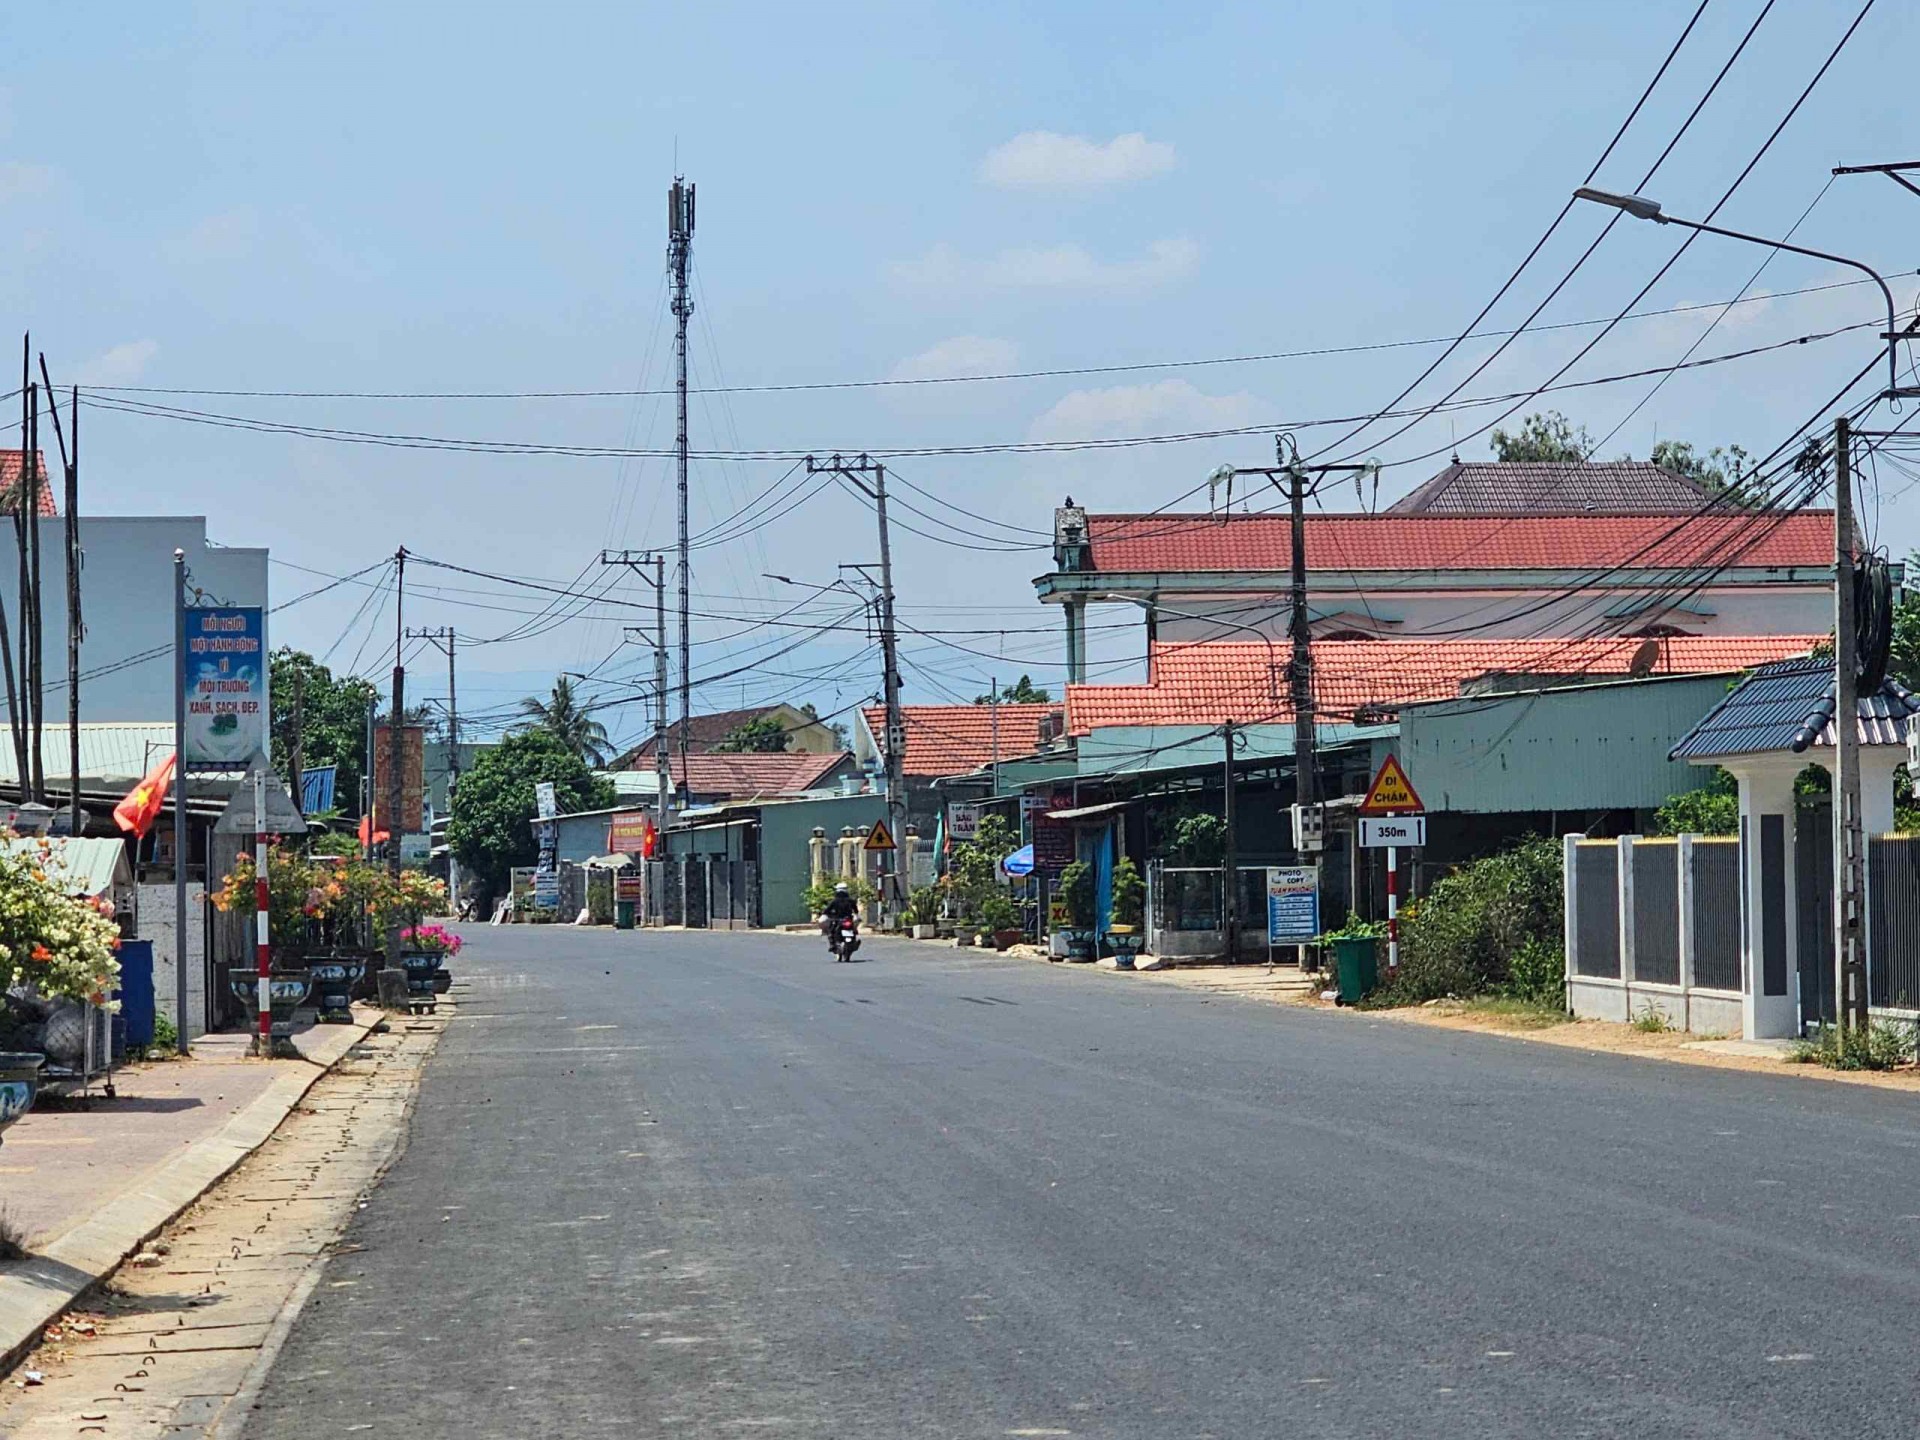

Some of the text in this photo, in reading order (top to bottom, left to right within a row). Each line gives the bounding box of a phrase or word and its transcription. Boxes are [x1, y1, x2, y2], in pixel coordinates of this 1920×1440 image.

[190, 637, 208, 654] MỘT
[234, 637, 258, 654] ĐỘNG
[217, 677, 249, 693] TRƯỜNG
[189, 701, 213, 714] XANH,
[1385, 777, 1397, 785] ĐI
[1374, 791, 1408, 804] CHẬM
[1378, 827, 1407, 837] 350m
